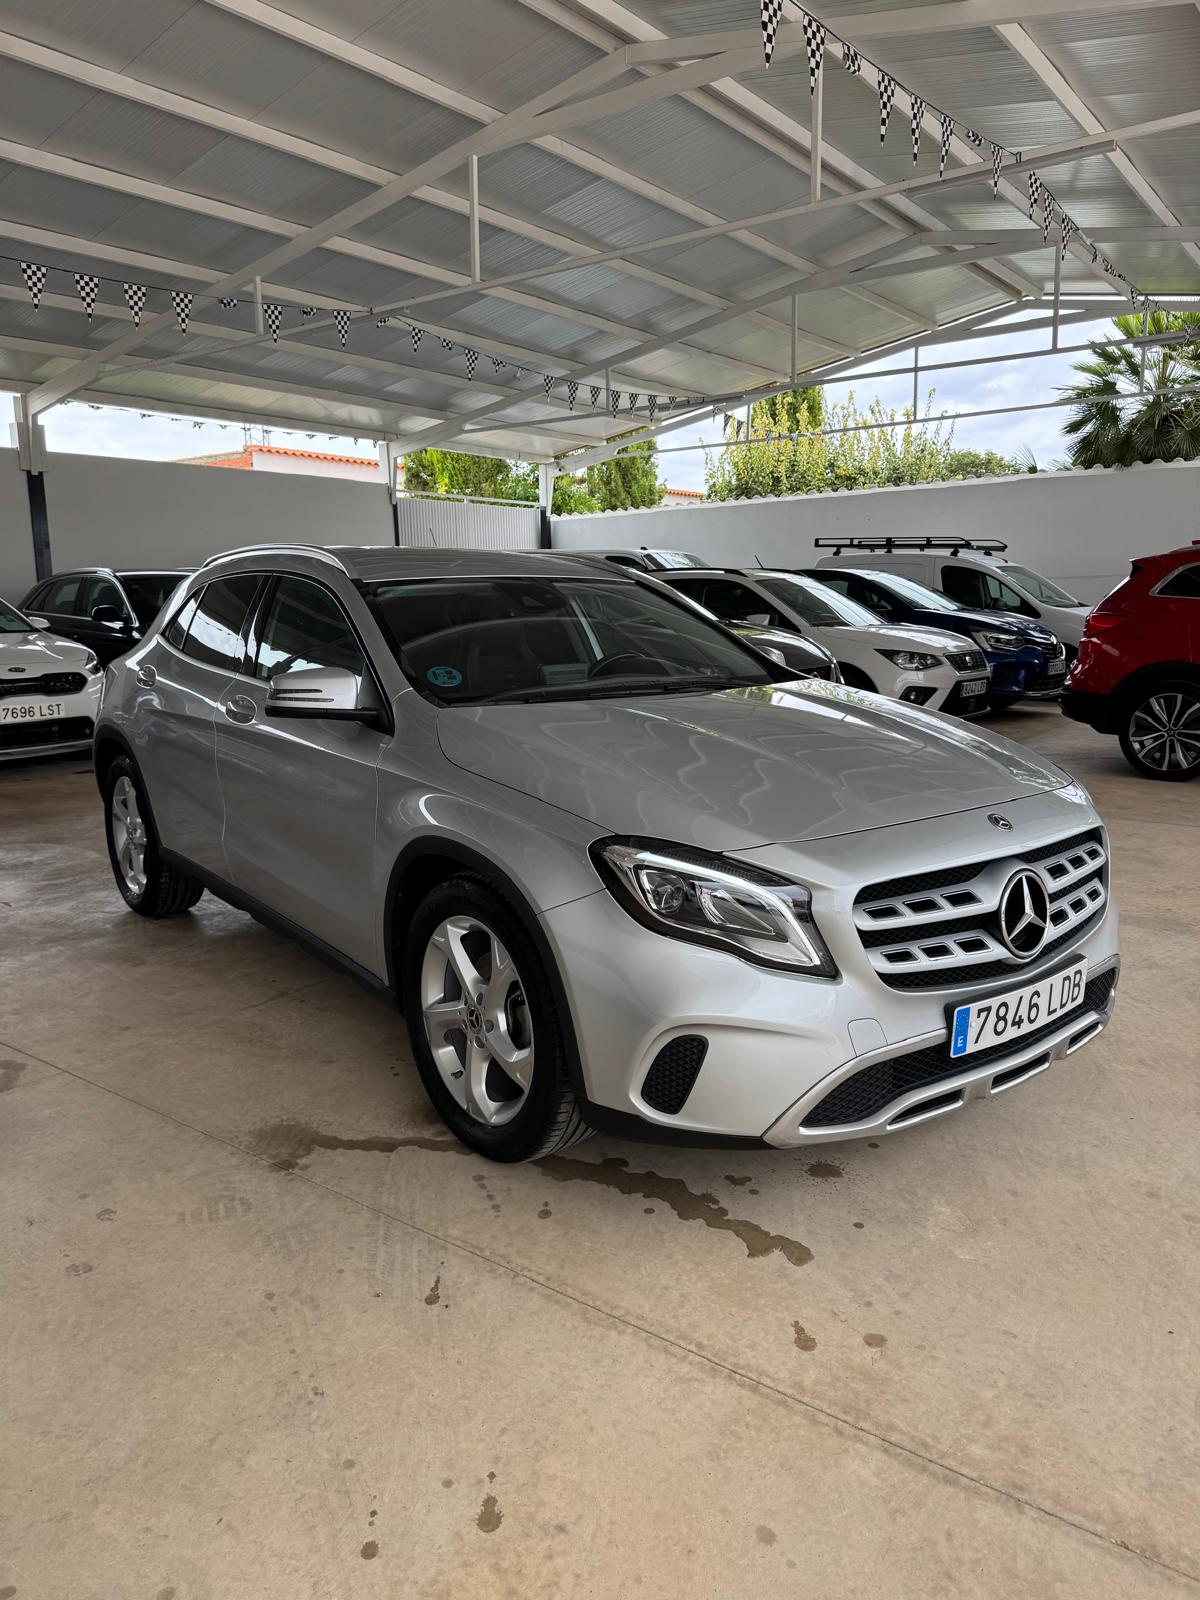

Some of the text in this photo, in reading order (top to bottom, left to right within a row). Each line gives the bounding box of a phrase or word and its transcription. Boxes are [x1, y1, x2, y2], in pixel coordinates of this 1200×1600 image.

[2, 703, 62, 720] 7696 LST
[974, 969, 1083, 1045] 7846 LDB
[957, 1035, 964, 1047] E
